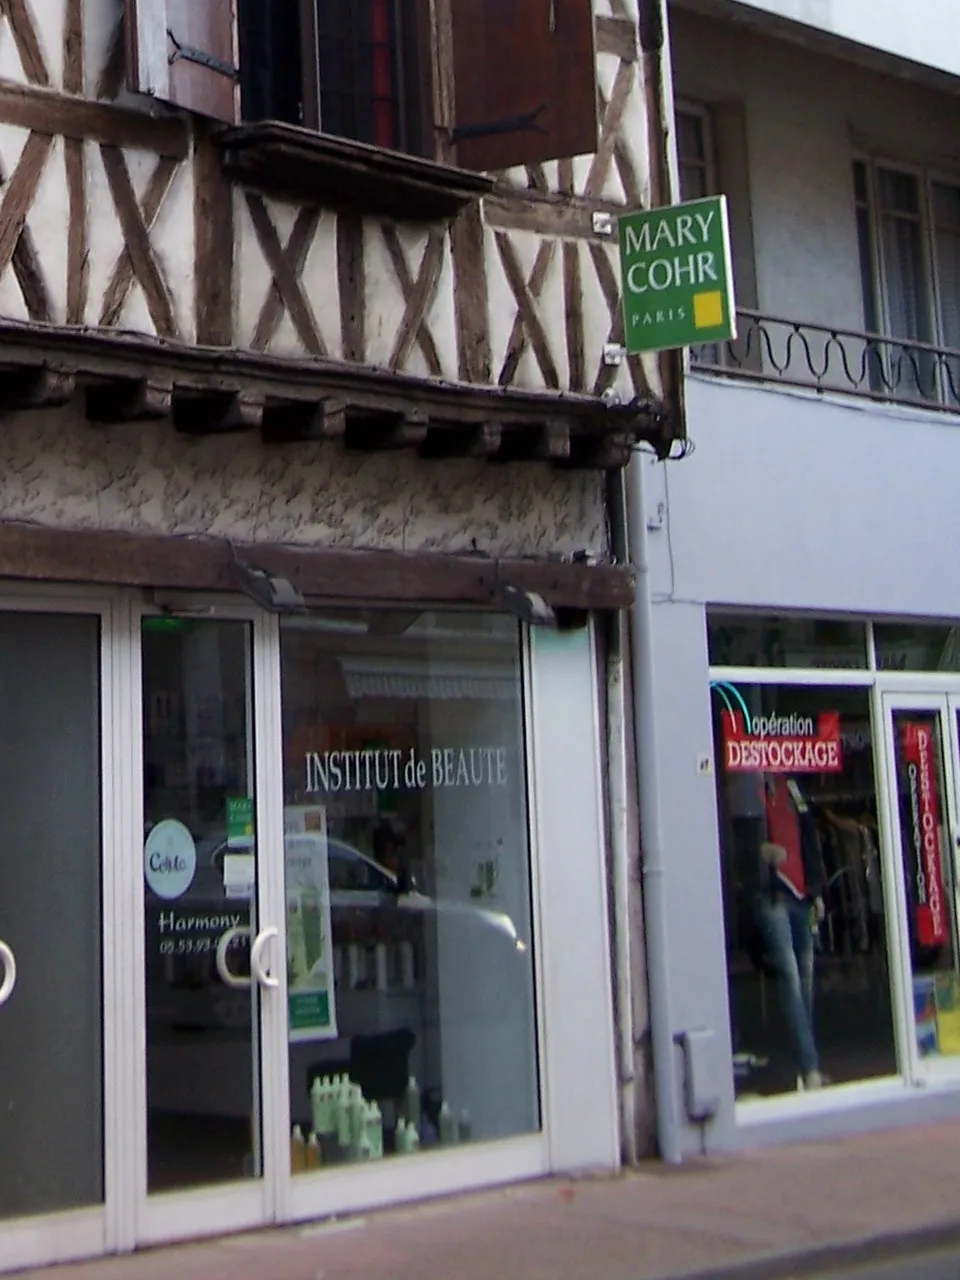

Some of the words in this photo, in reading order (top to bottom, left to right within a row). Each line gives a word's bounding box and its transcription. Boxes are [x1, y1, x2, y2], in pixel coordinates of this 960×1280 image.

[625, 210, 715, 255] MARY
[627, 251, 718, 294] COHR
[632, 306, 685, 327] PARIS
[751, 711, 813, 741] opération
[727, 738, 838, 768] DESTOCKAGE
[304, 749, 402, 793] INSTITUT
[404, 748, 427, 788] de
[431, 747, 507, 787] BEAUTE
[158, 911, 240, 934] Harmony
